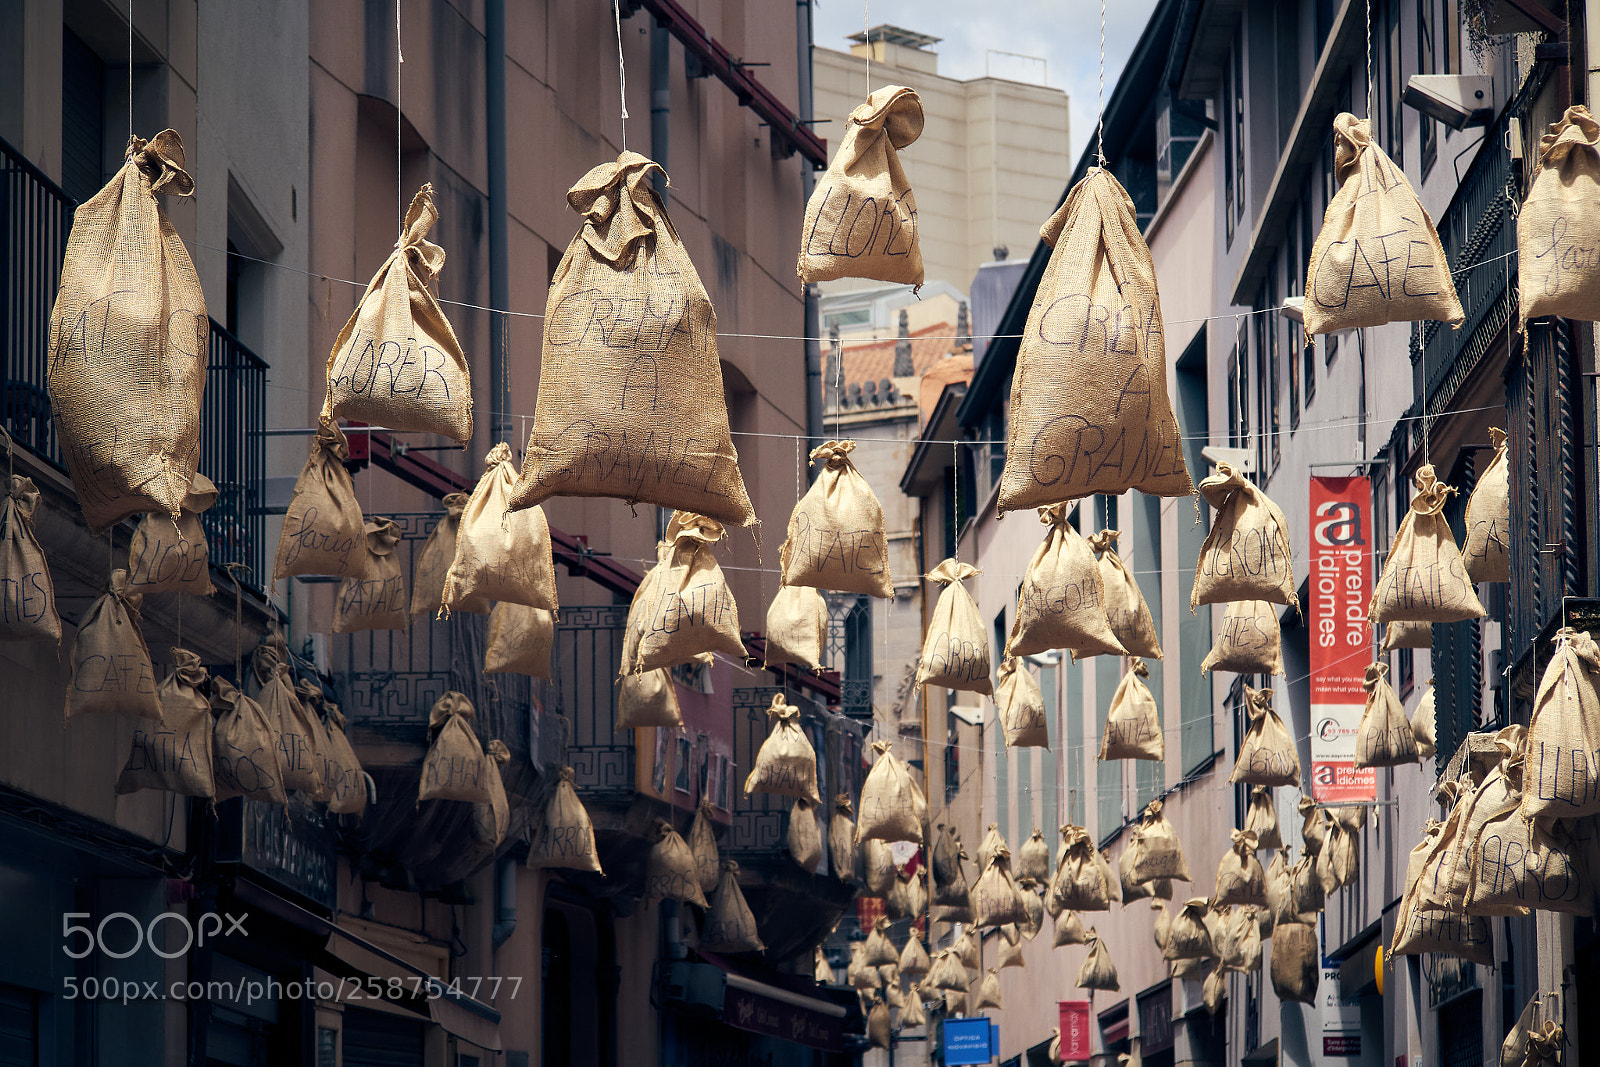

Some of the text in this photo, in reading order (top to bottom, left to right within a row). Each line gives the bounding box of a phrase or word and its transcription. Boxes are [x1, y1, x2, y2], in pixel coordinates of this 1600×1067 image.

[1536, 216, 1600, 297] far
[1115, 363, 1151, 421] A
[1318, 550, 1341, 648] idiomes
[1341, 549, 1368, 647] prendre
[1337, 776, 1375, 785] idiomes
